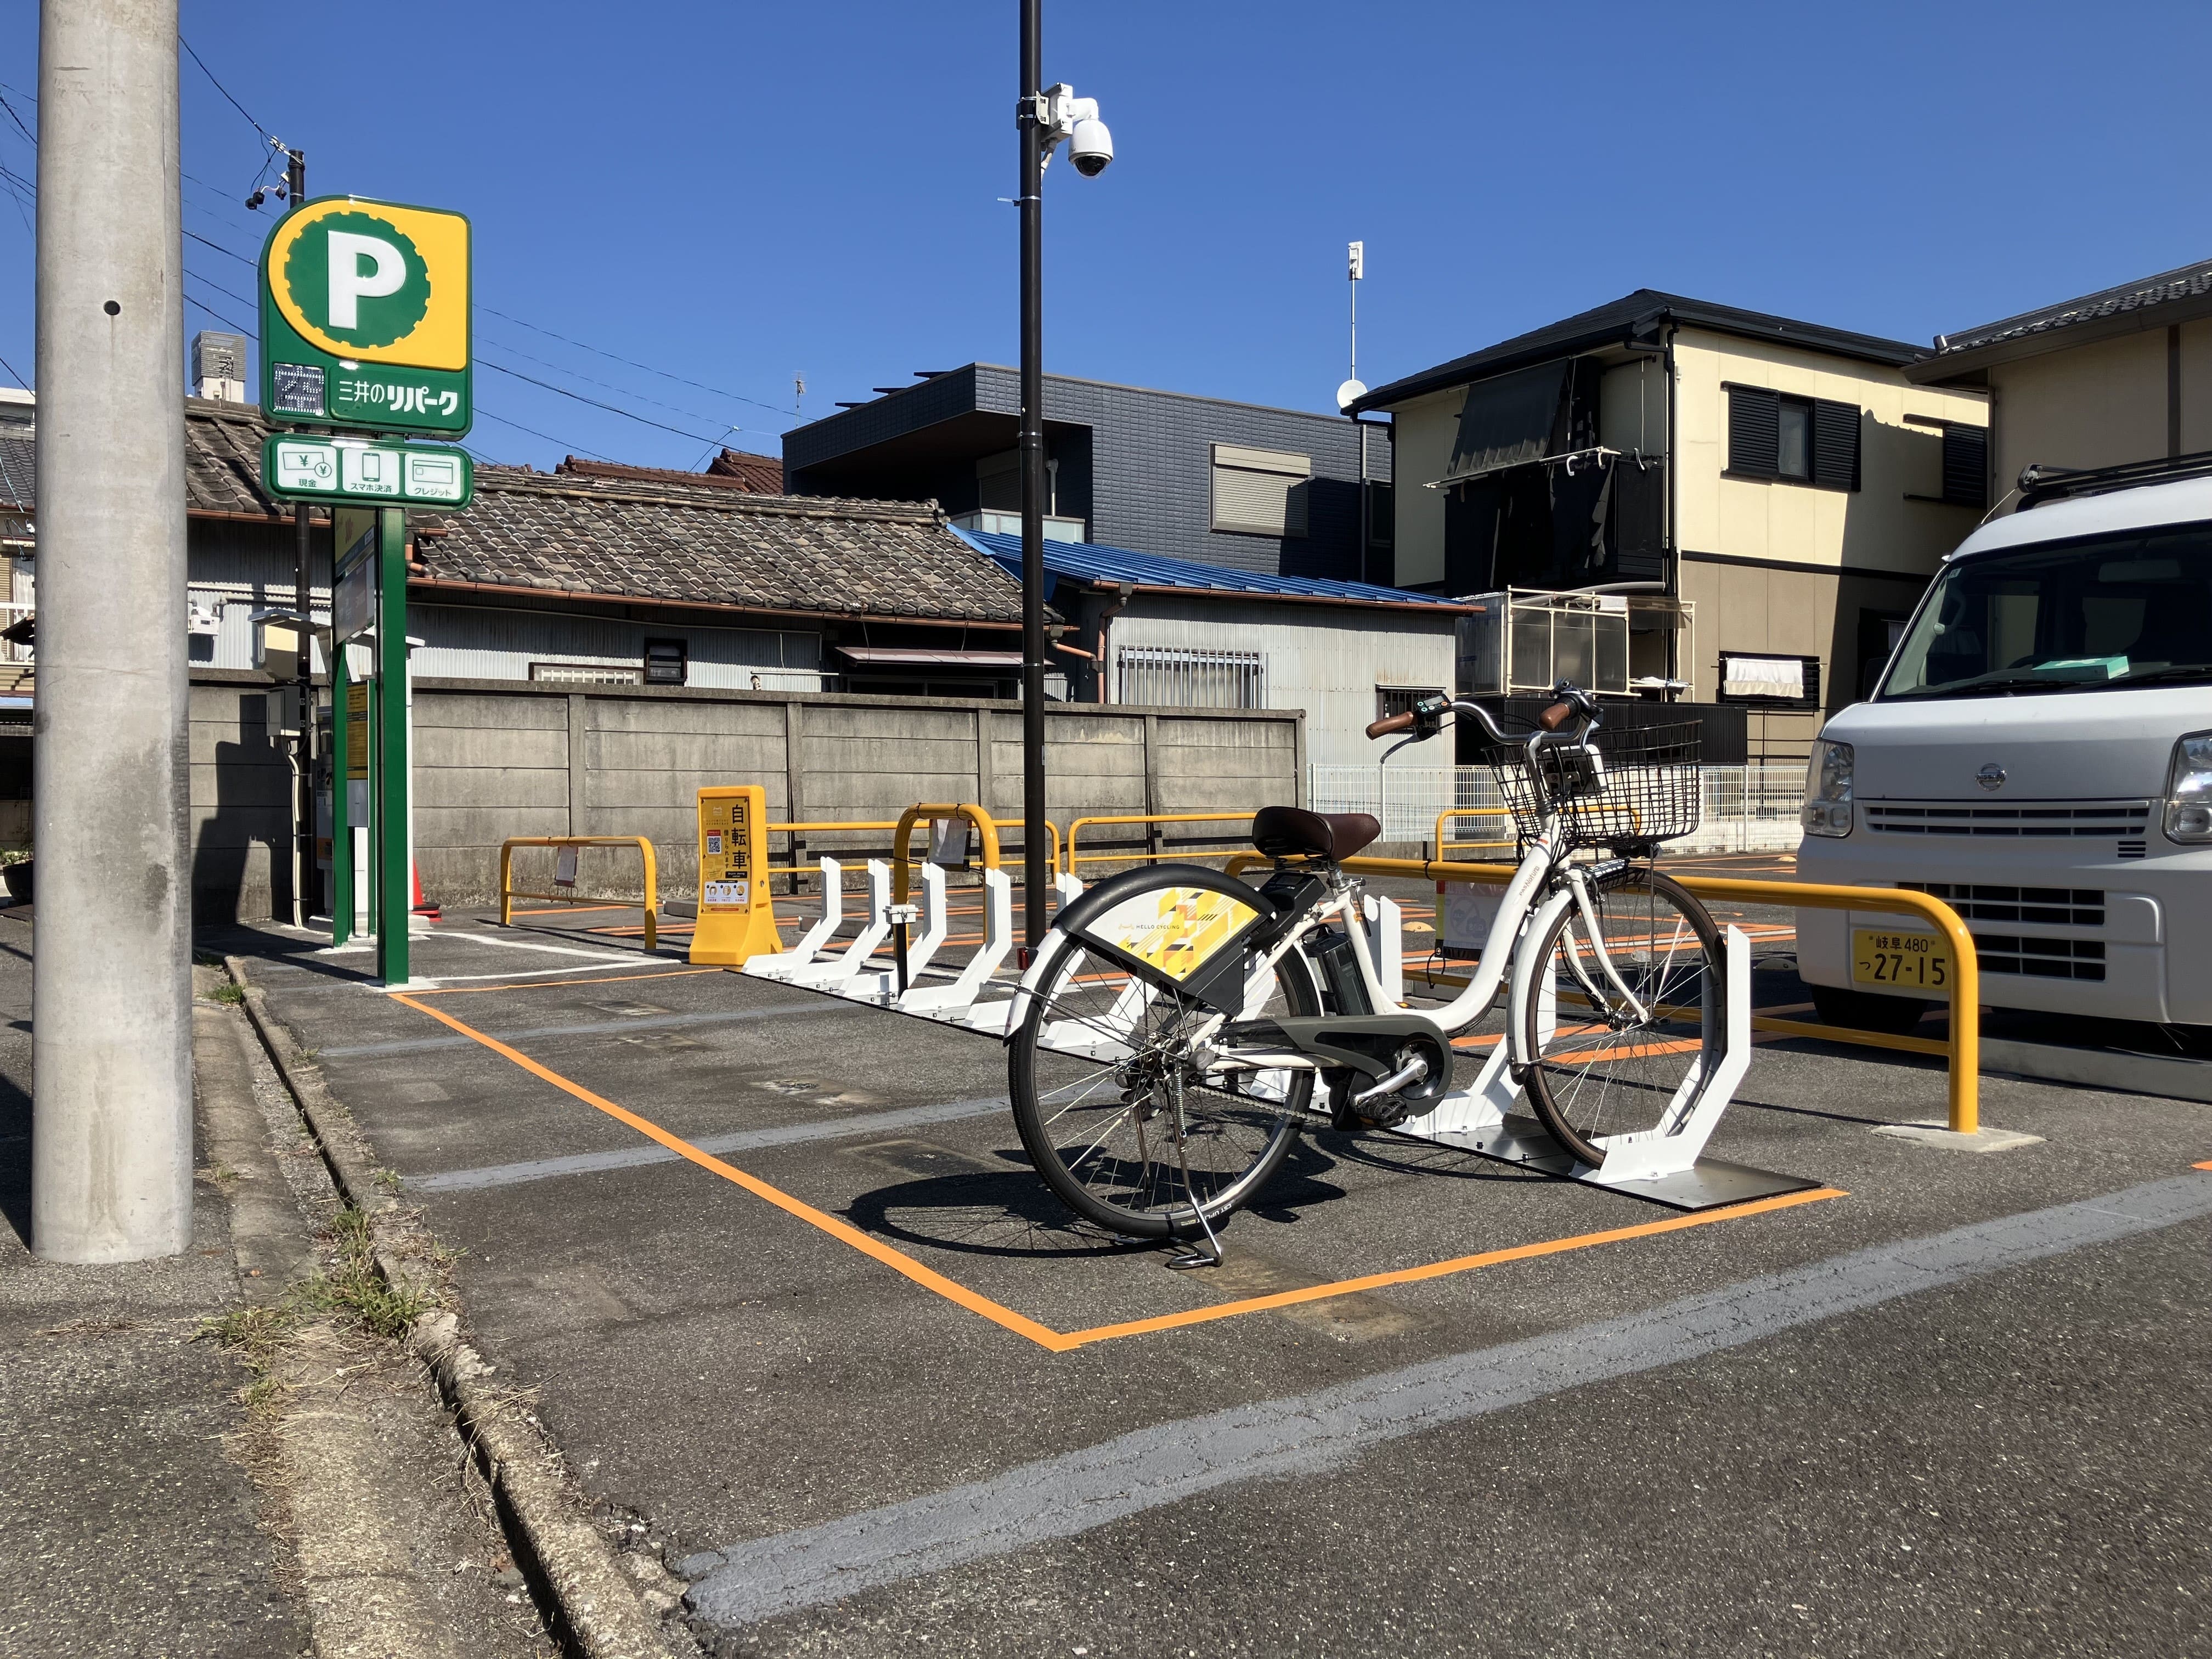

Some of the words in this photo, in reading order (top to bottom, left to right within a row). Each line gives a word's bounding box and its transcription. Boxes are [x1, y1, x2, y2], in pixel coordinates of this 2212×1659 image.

[328, 230, 406, 330] P
[274, 366, 324, 413] 空
[338, 380, 458, 415] 三井のリパーク
[298, 478, 317, 487] 現金
[351, 483, 392, 493] スマホ決済
[414, 488, 451, 497] クレジット
[731, 804, 747, 870] 自転車
[1876, 936, 1901, 950] 岐阜
[1904, 938, 1928, 952] 480
[1859, 962, 1870, 970] つ
[1875, 953, 1945, 985] 27-15
[1221, 1203, 1232, 1213] CST
[1197, 1211, 1220, 1223] UPLIT
